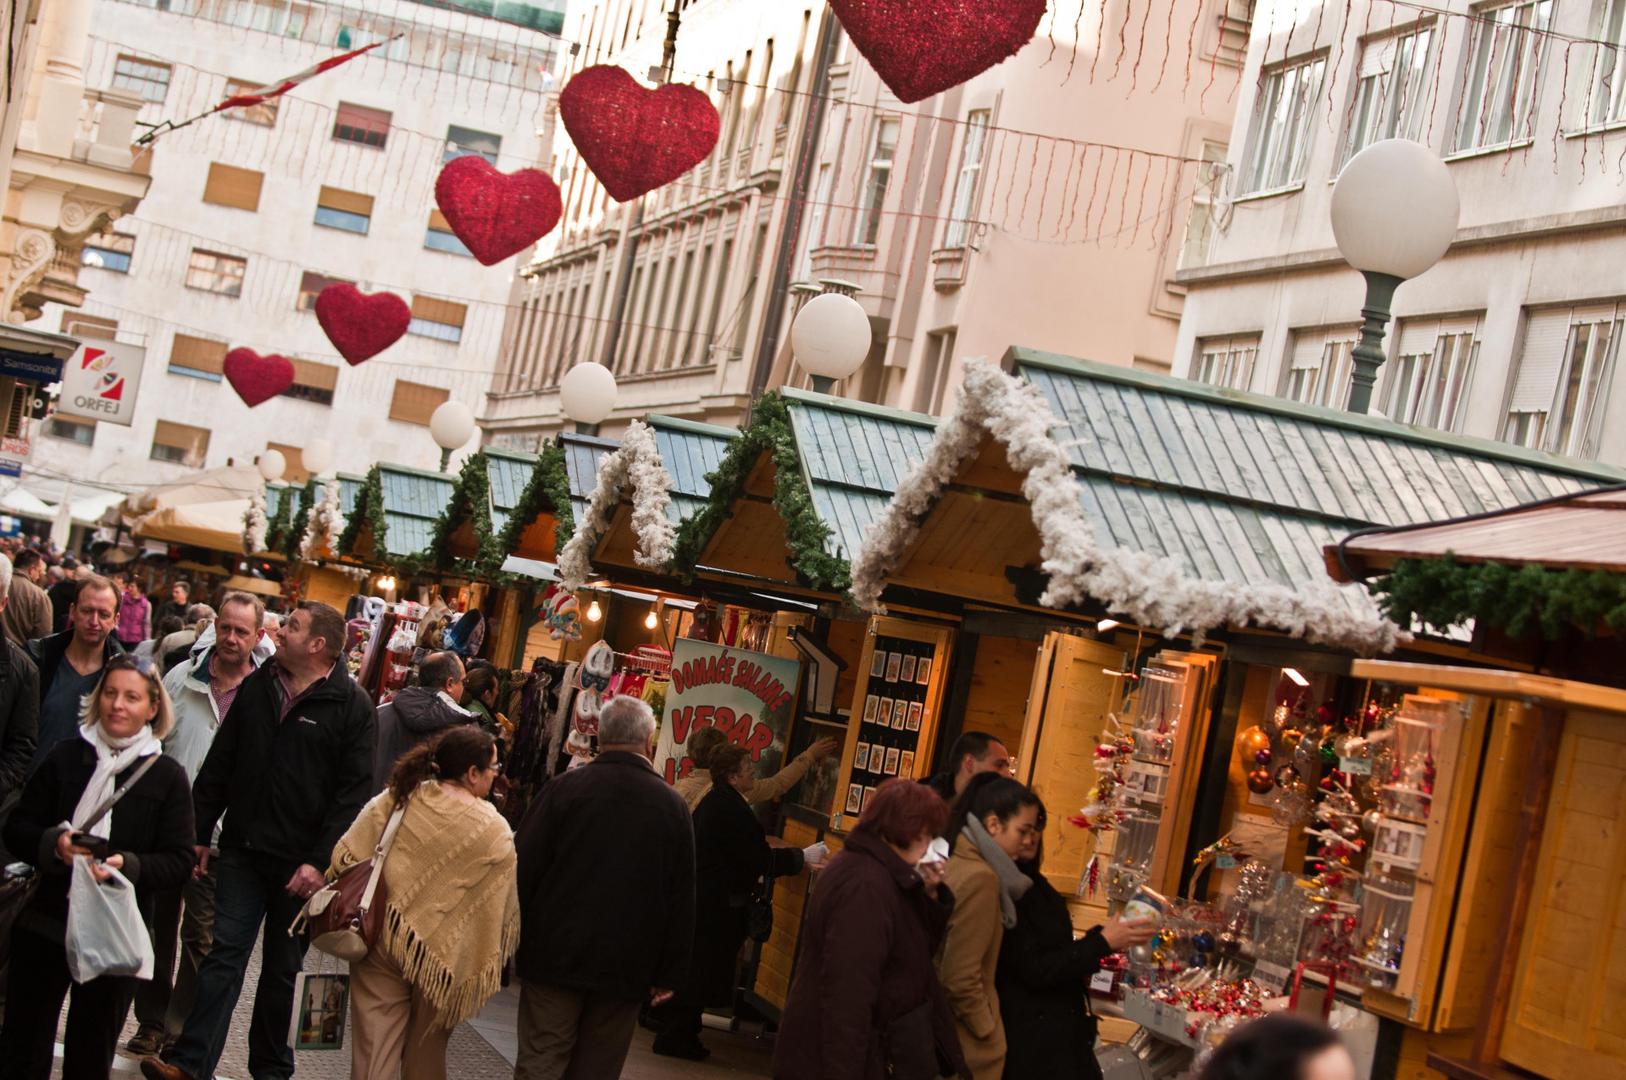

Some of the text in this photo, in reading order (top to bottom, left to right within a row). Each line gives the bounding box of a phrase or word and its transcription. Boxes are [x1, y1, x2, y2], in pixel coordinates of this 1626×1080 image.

[4, 357, 57, 376] Samsonite
[74, 395, 121, 415] ORFEJ
[732, 661, 792, 712] SALAME
